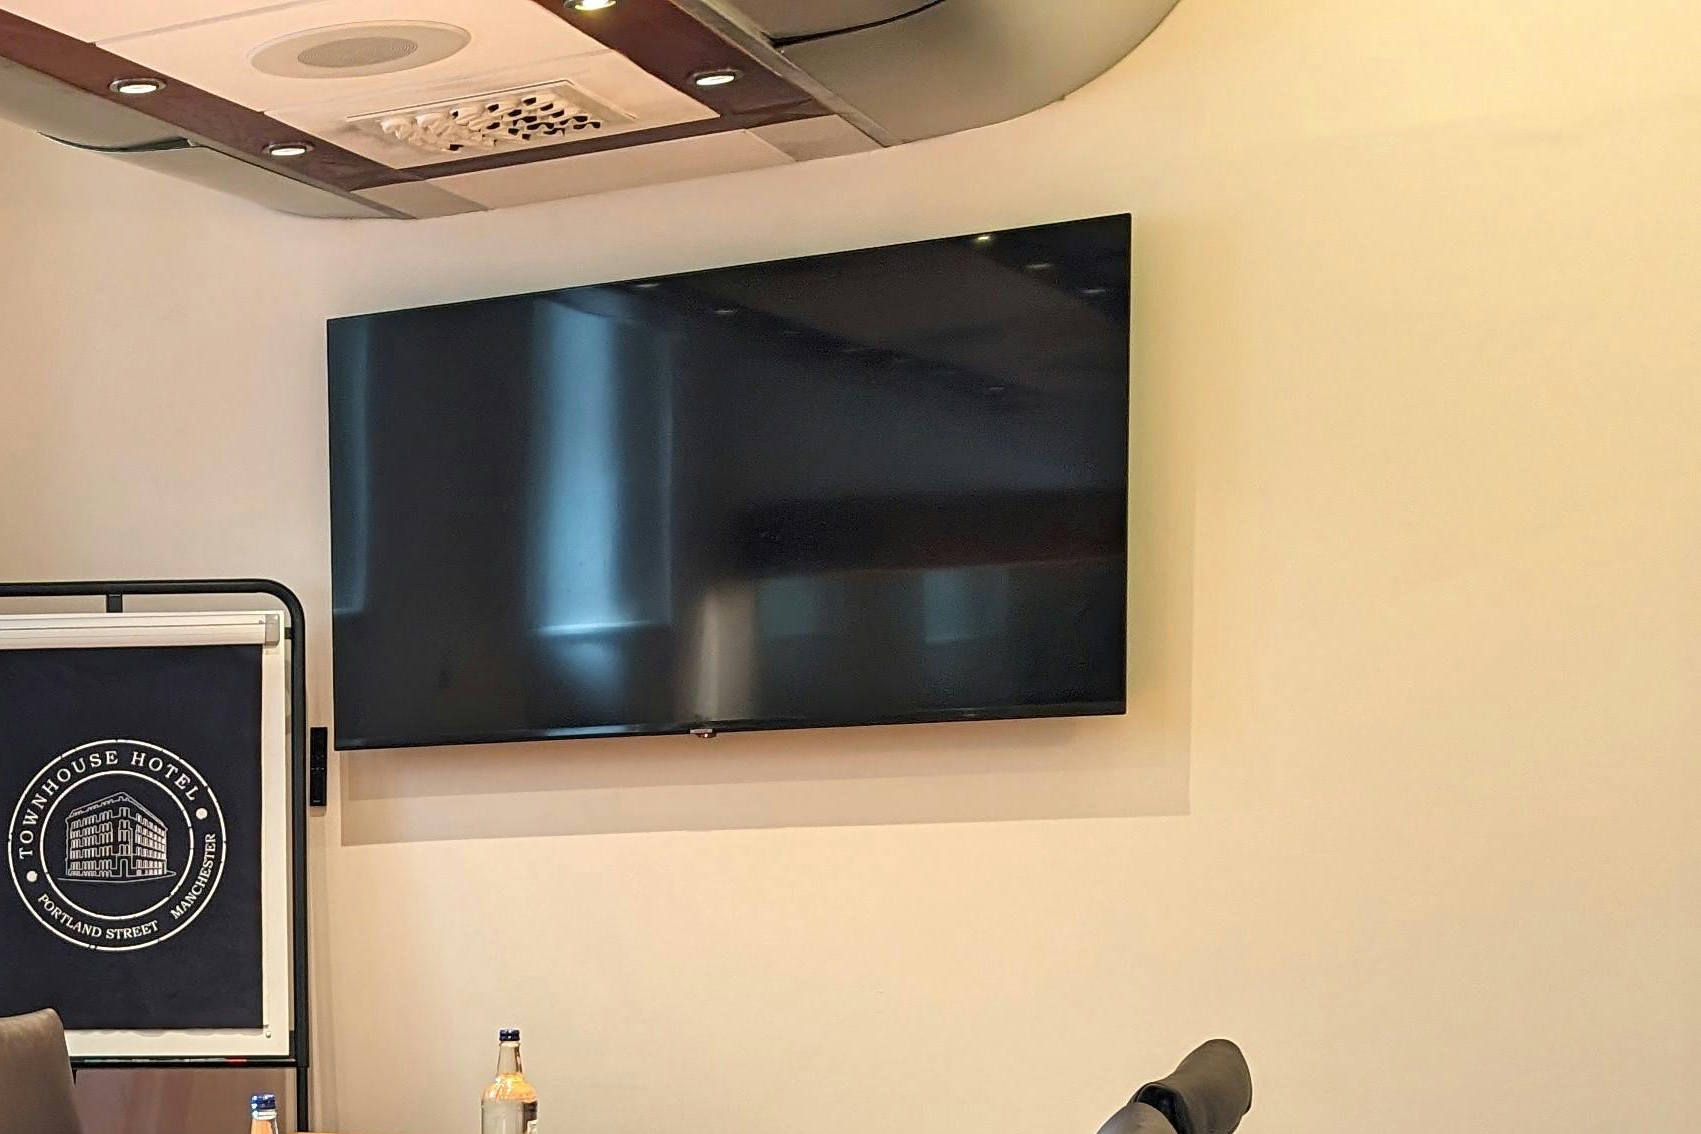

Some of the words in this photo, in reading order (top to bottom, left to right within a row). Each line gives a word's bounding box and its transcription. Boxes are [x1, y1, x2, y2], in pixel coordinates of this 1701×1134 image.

[19, 750, 118, 859] TOWNHOUSE
[131, 751, 200, 801] HOTEL
[37, 894, 102, 939] PORTLAND
[105, 920, 159, 940] STREET
[170, 833, 217, 920] MANCHESTER
